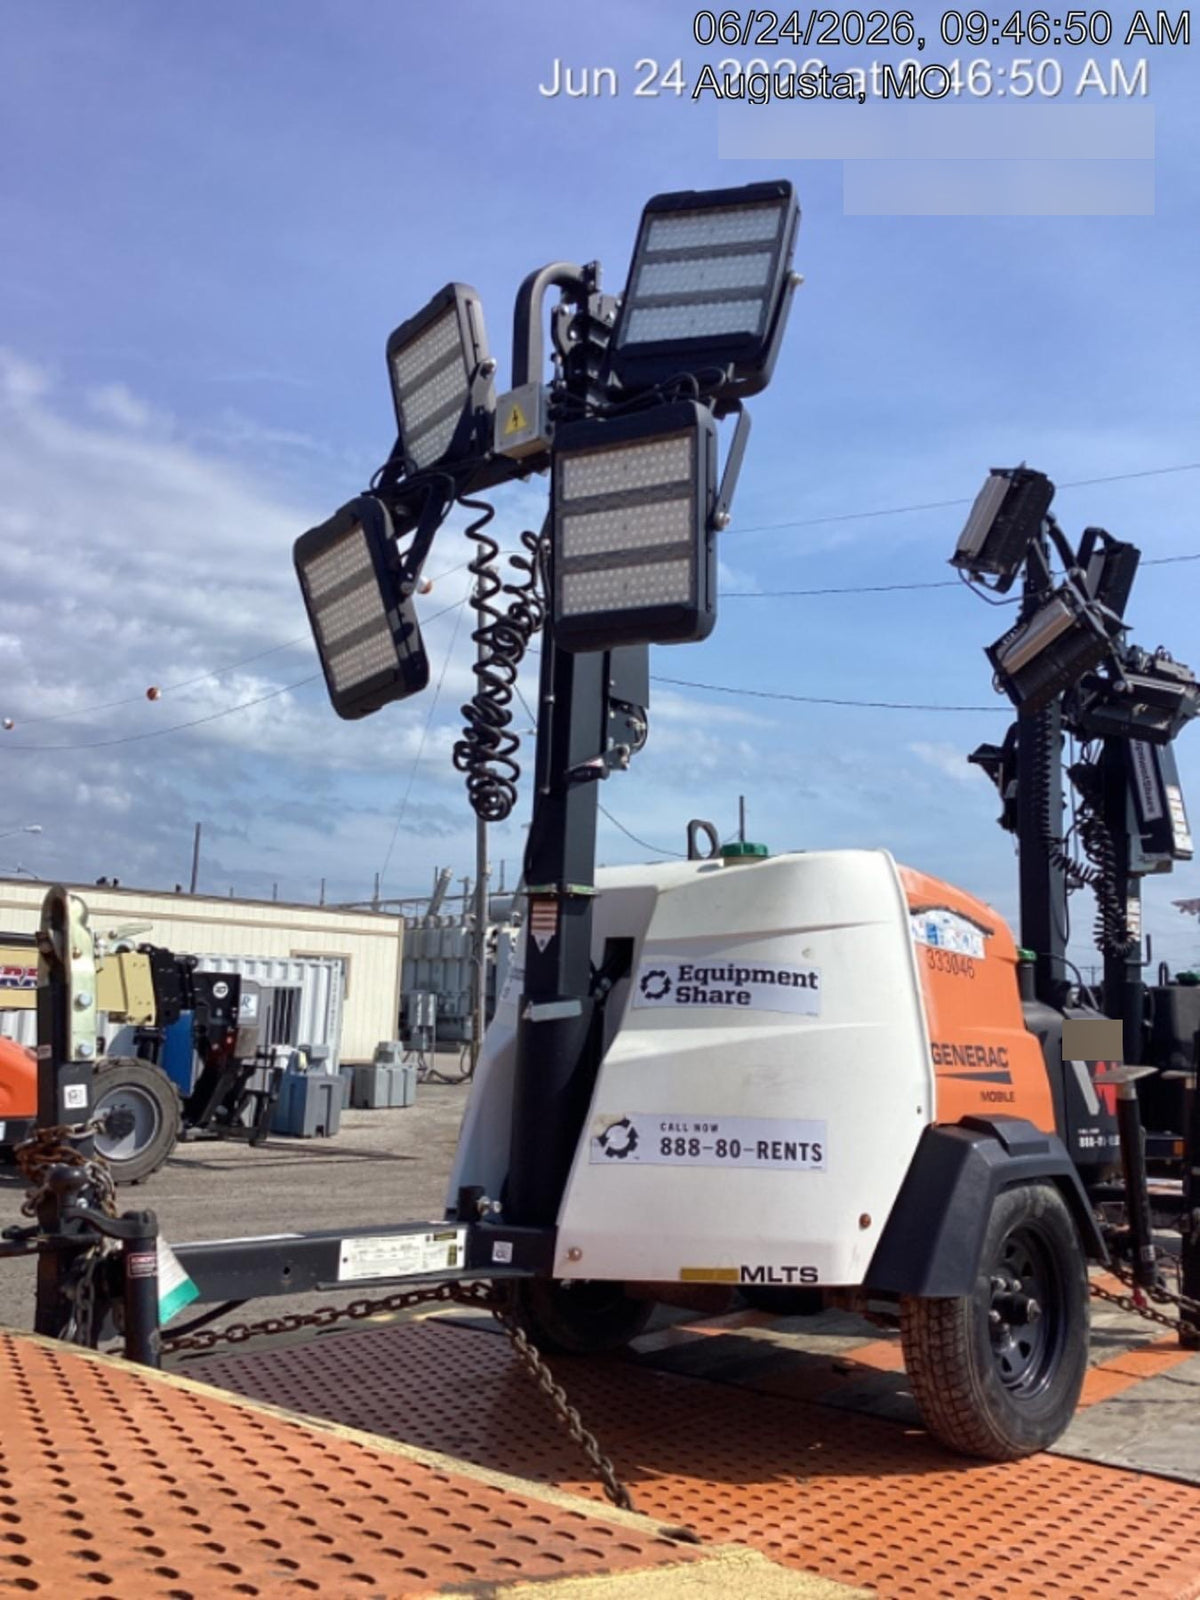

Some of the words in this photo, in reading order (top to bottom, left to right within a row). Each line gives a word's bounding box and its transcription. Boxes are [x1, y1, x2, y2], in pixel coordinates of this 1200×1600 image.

[677, 963, 819, 990] Equipment
[674, 985, 751, 1006] Share
[930, 1042, 1009, 1068] GENERAC
[980, 1090, 1015, 1103] MOBILE
[659, 1122, 689, 1133] CALL
[694, 1122, 719, 1133] NOW
[659, 1136, 823, 1163] 888-80-RENTS
[740, 1265, 818, 1284] MLTS
